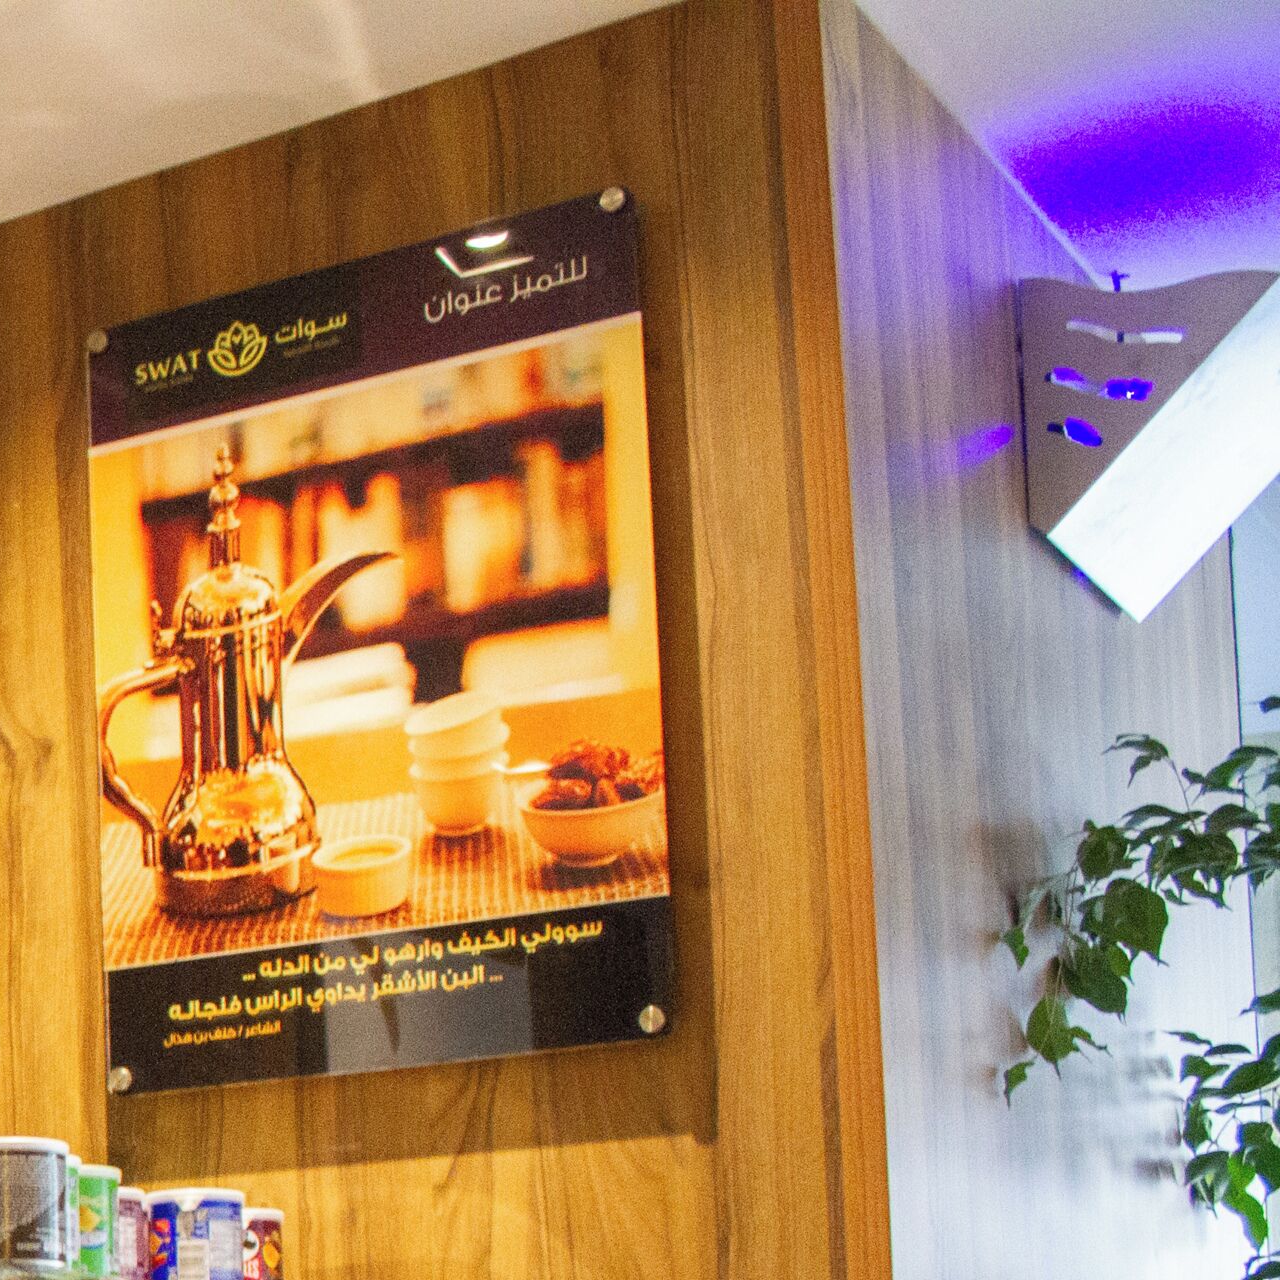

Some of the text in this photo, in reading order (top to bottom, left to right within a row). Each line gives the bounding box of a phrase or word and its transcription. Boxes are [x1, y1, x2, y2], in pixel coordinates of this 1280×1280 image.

[424, 255, 587, 323] للتميز عنوان
[274, 312, 348, 344] سوات
[135, 349, 201, 386] SWAT
[447, 926, 516, 956] الكيف
[313, 951, 347, 976] من
[441, 963, 486, 992] البن
